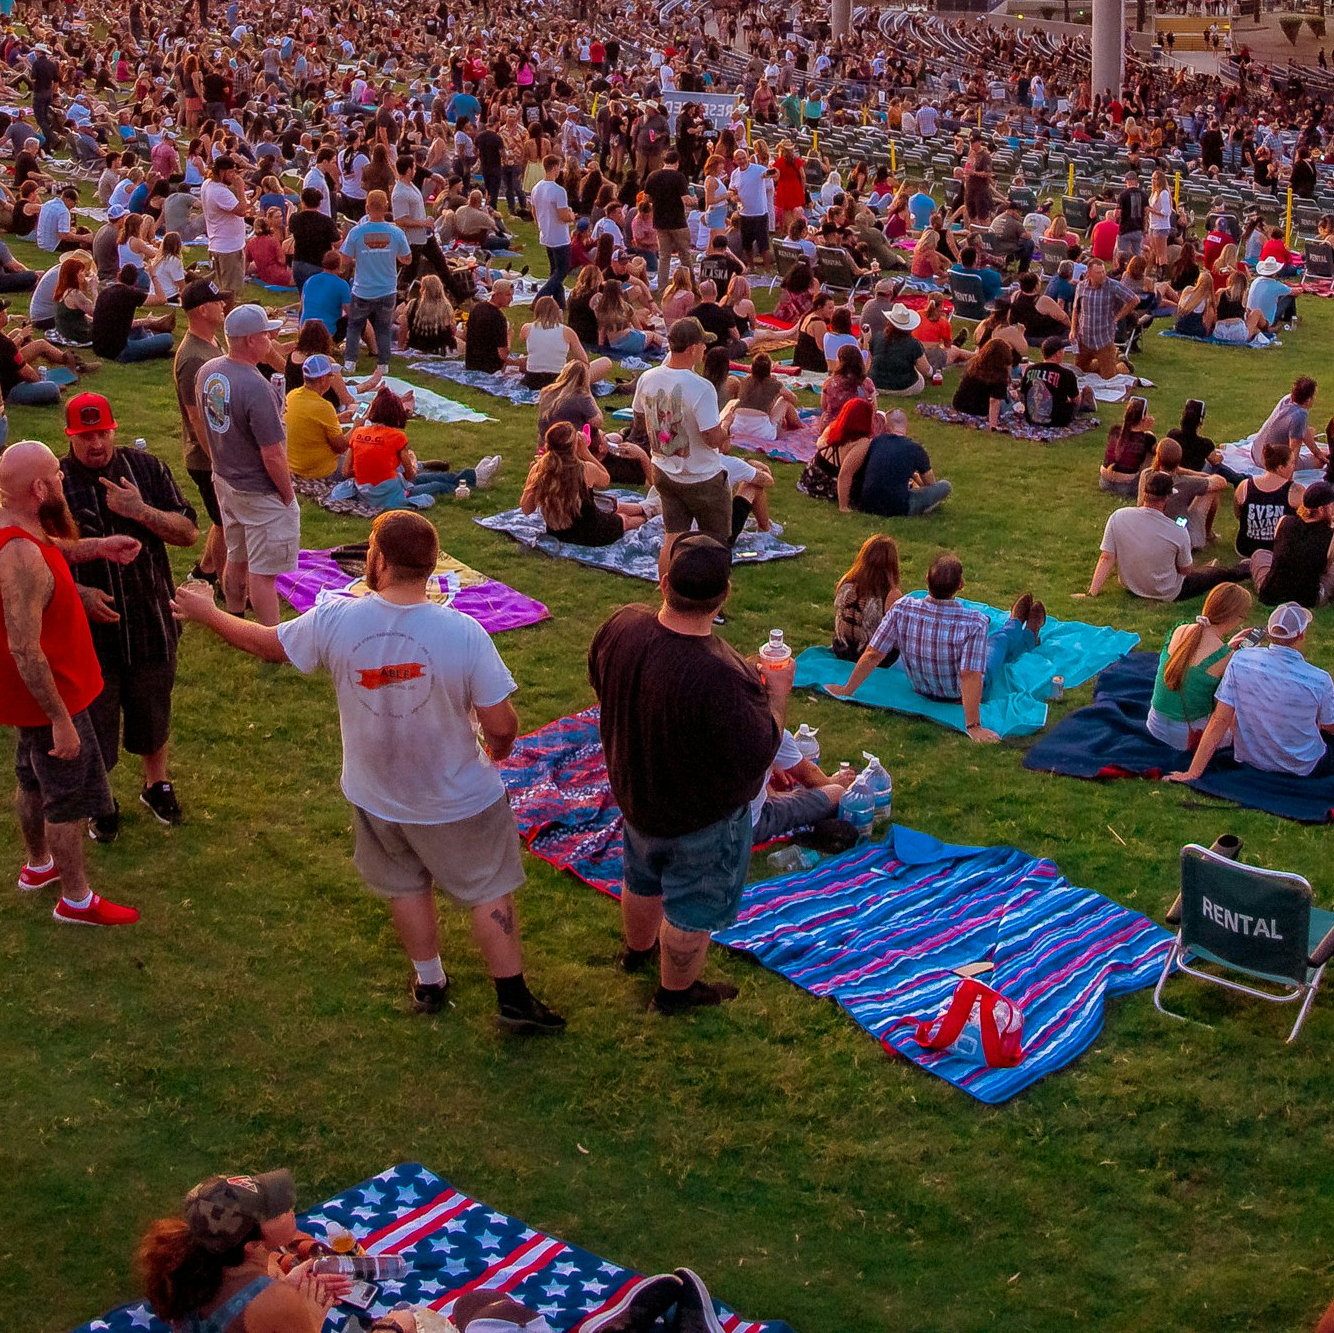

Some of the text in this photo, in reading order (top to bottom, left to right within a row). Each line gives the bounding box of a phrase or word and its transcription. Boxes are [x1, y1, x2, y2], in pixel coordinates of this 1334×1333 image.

[1308, 253, 1328, 263] RENTAL
[701, 268, 729, 280] ALASKA
[1247, 503, 1285, 520] EVEN
[381, 668, 410, 679] ABLE
[1202, 895, 1283, 940] RENTAL
